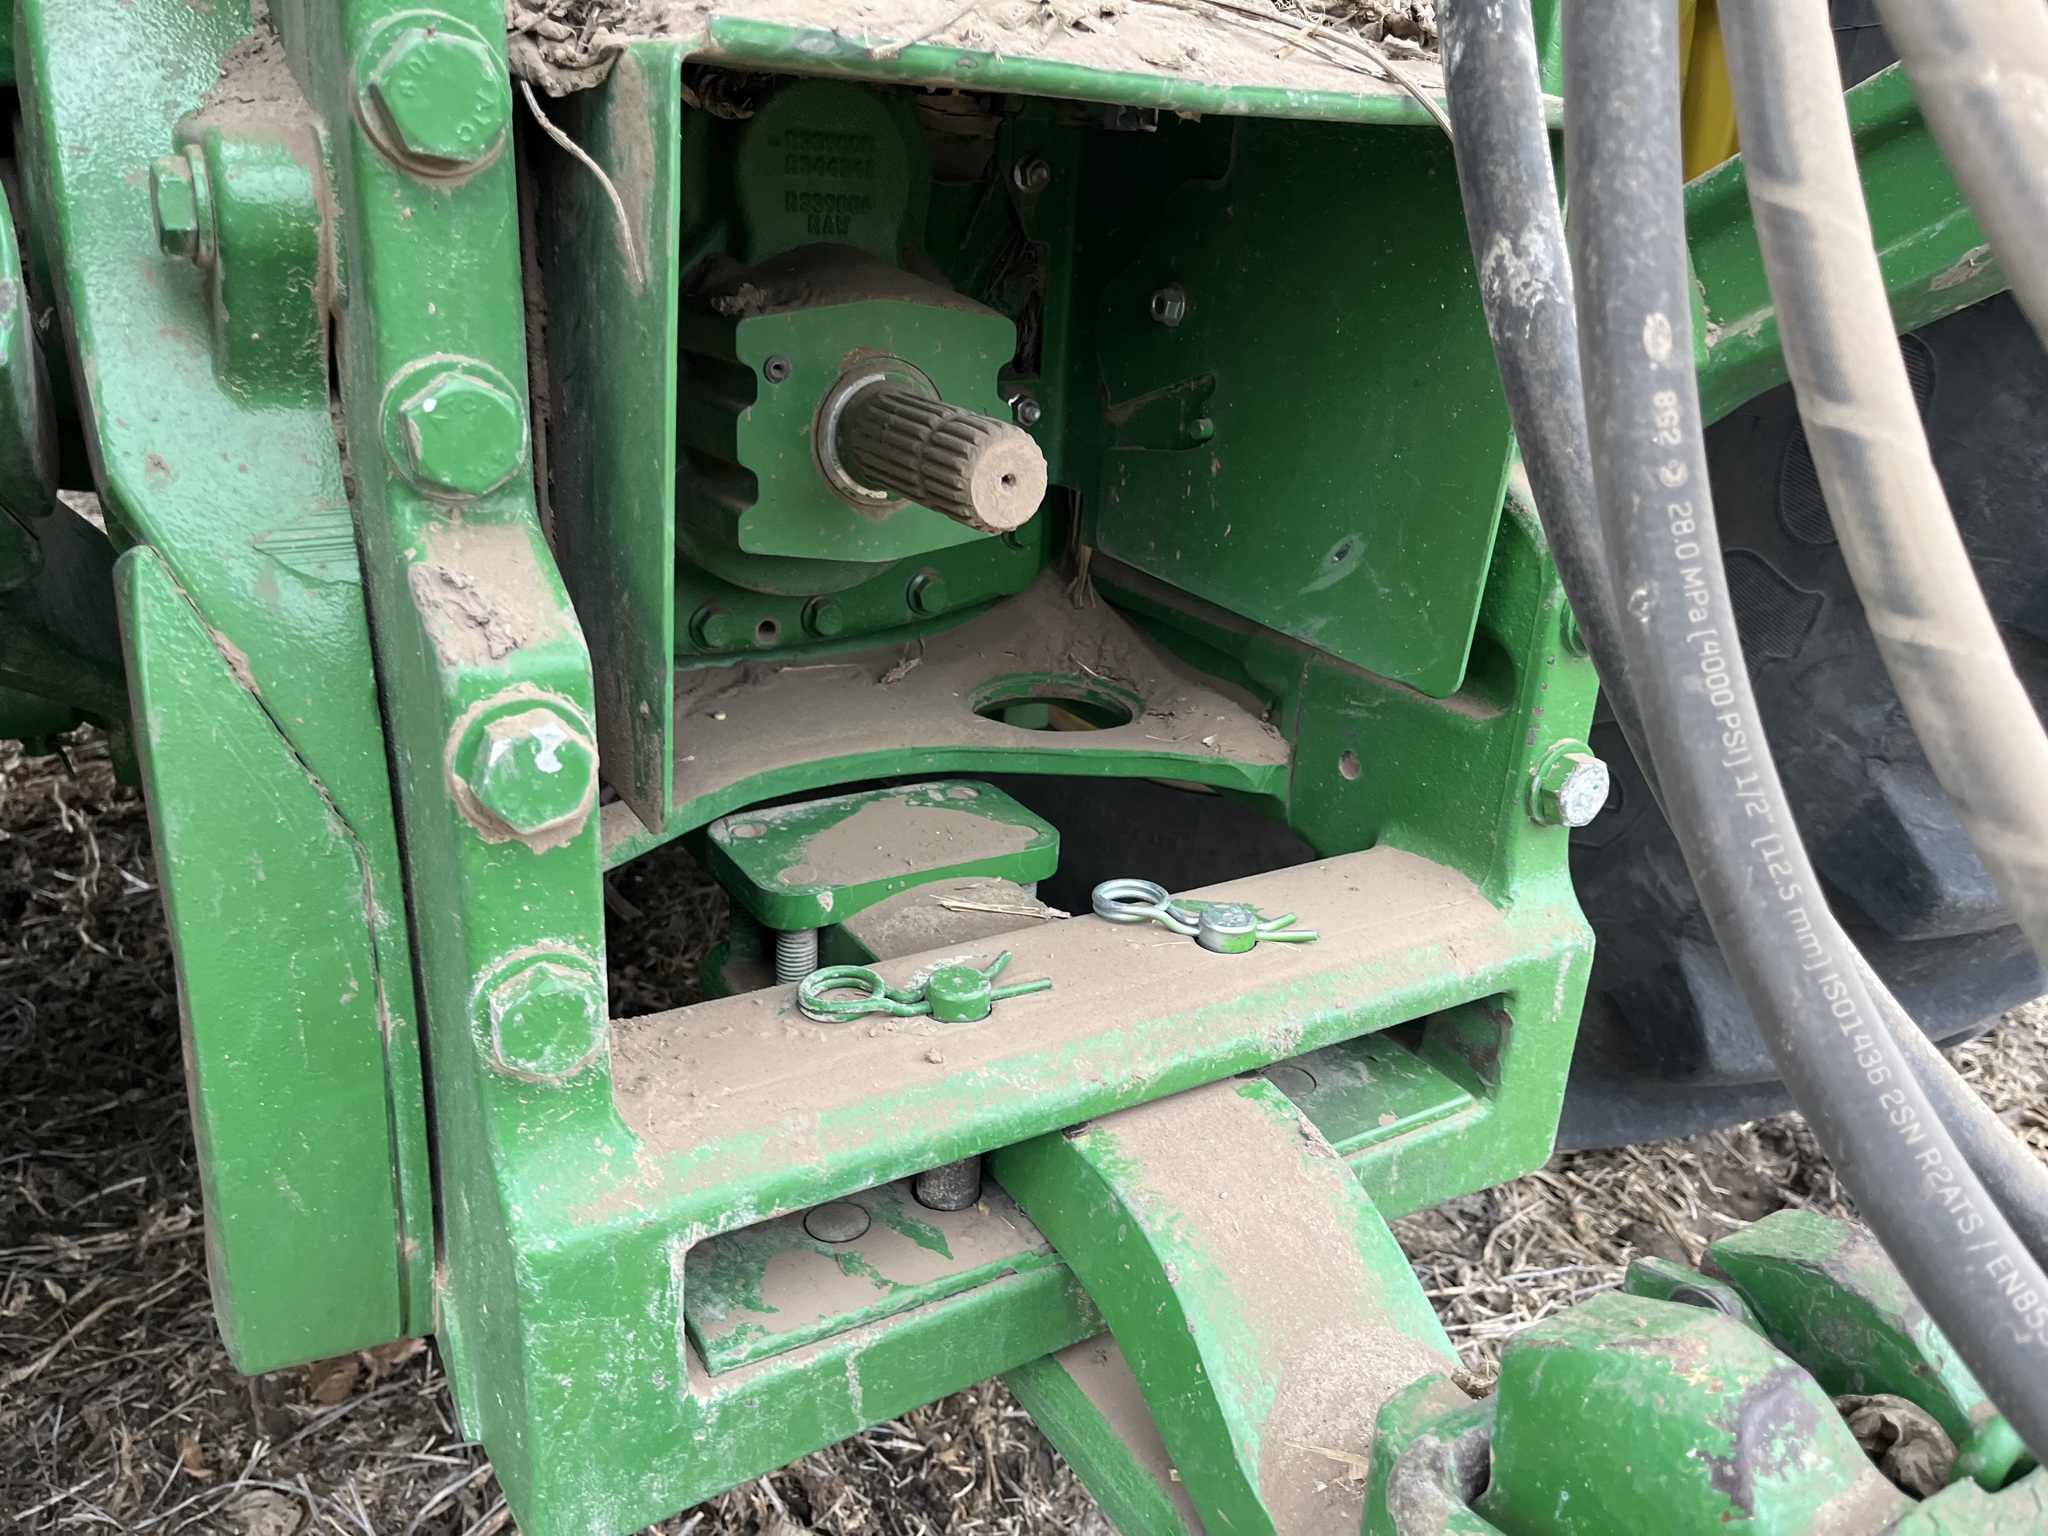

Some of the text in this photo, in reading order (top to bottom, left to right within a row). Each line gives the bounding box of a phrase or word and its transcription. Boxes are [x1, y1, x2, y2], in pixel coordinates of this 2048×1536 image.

[1667, 500, 1701, 560] 28.0
[1679, 564, 1711, 625] MPa
[1879, 1088, 1928, 1146] 2SN
[1914, 1147, 1984, 1235] R2ATS
